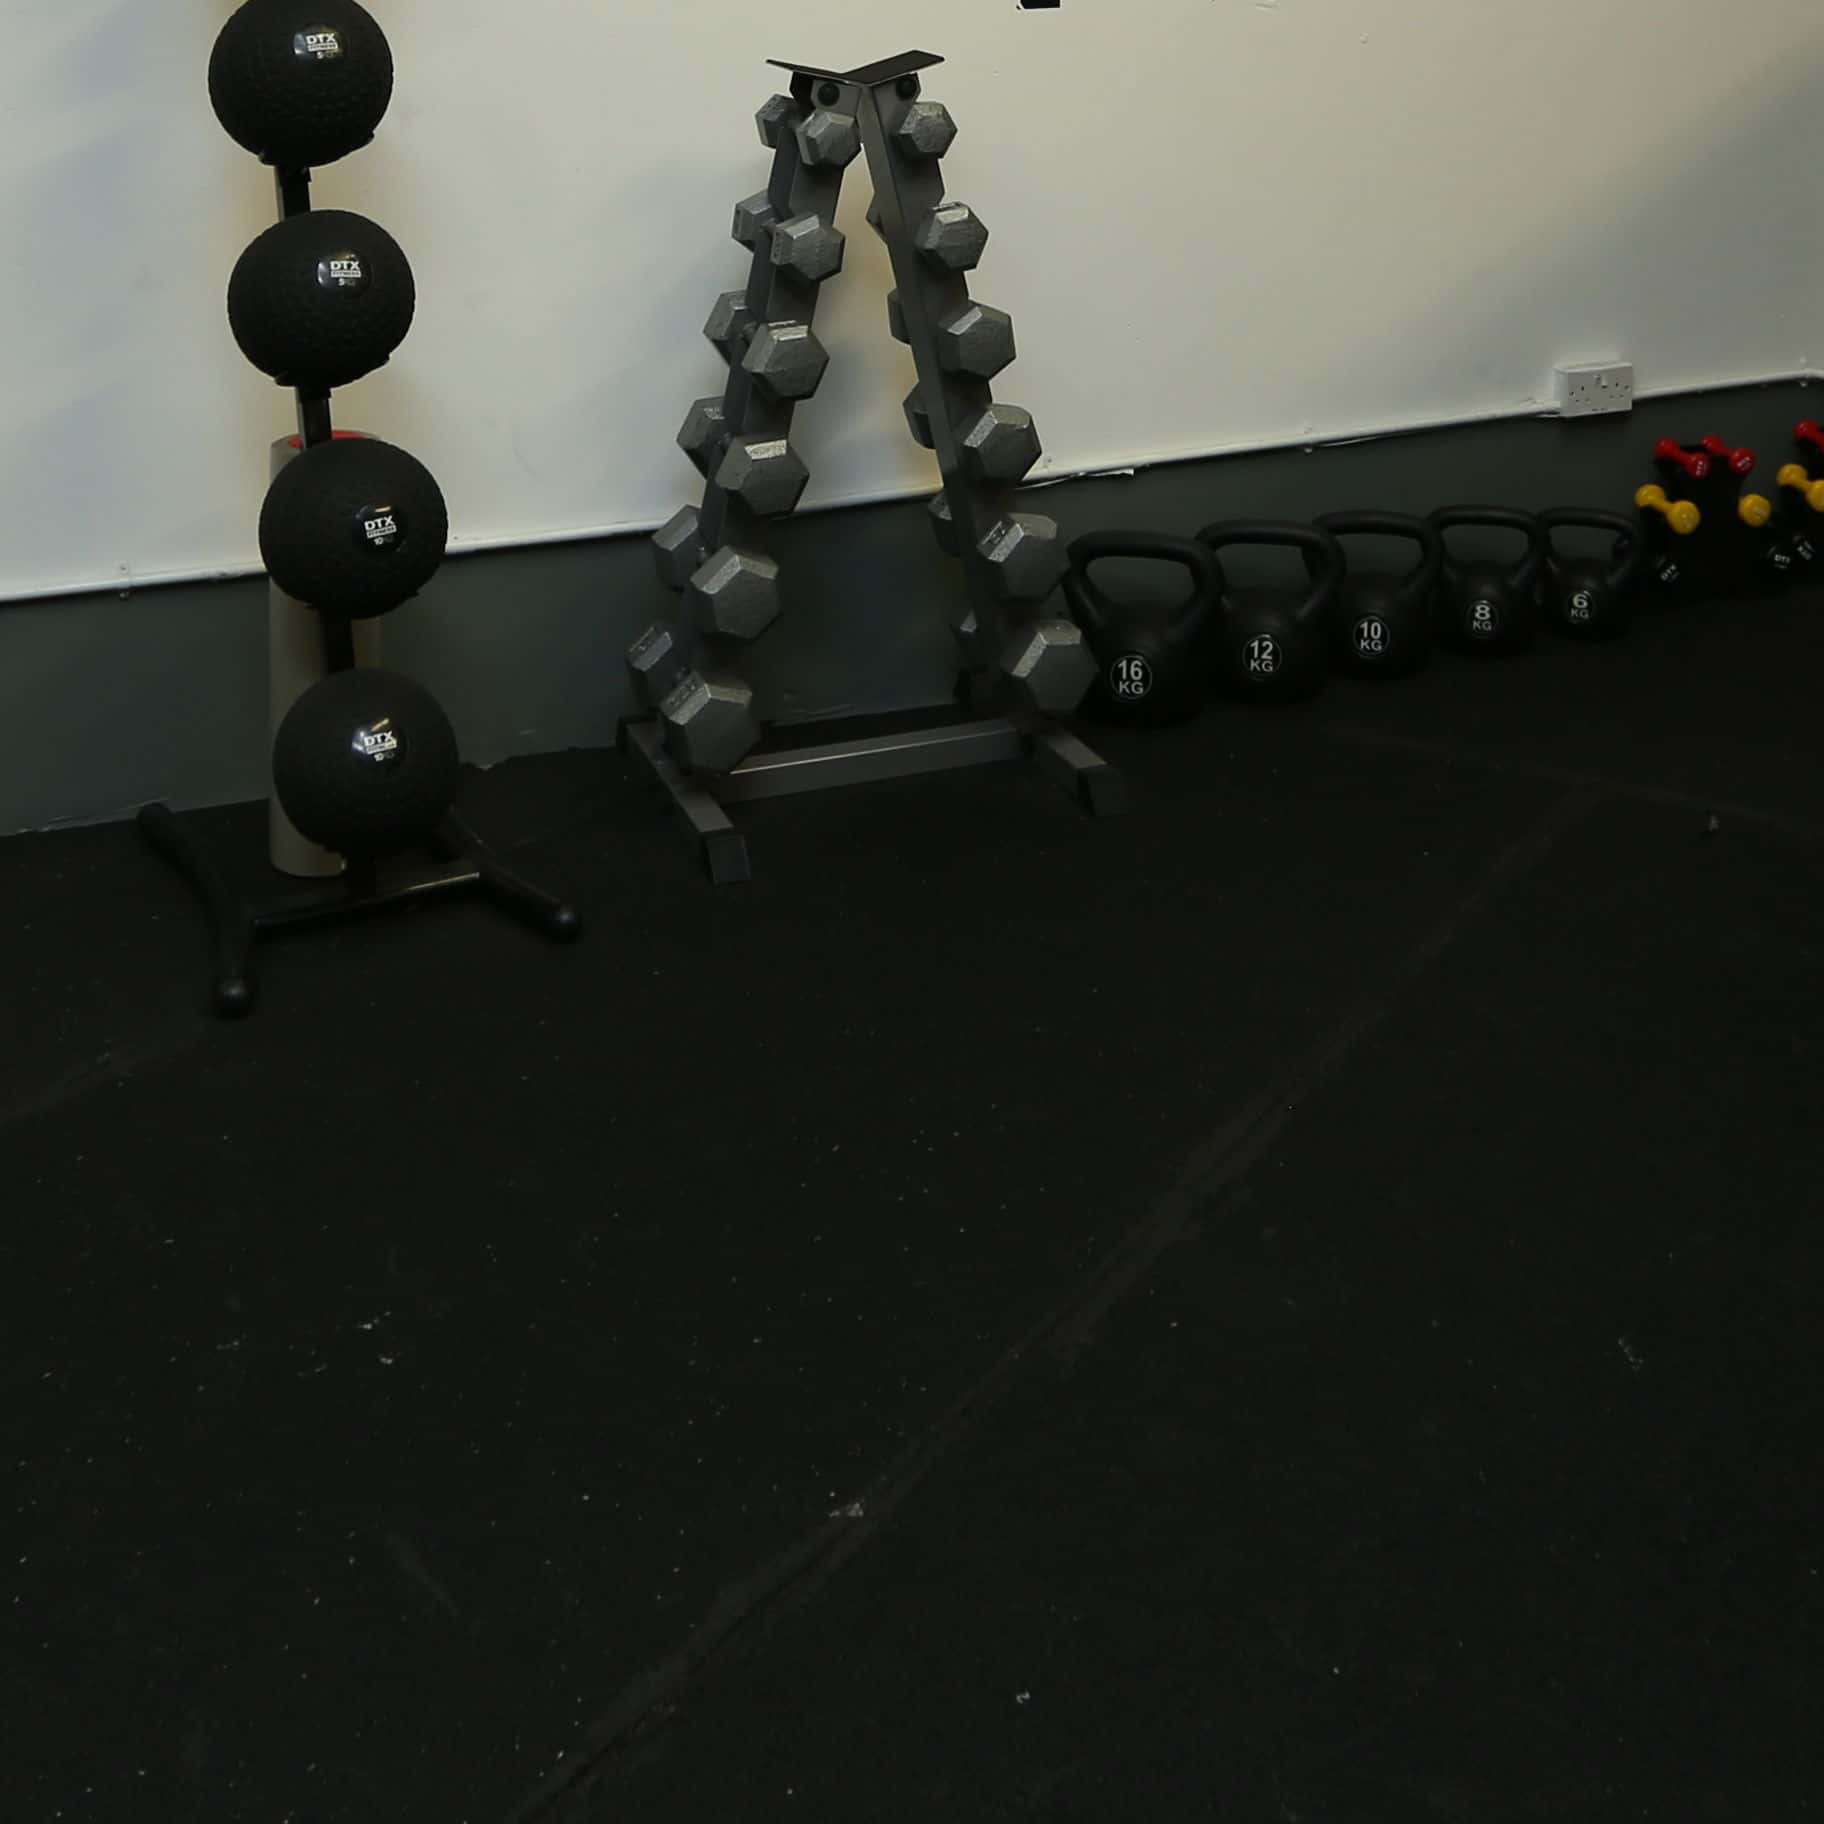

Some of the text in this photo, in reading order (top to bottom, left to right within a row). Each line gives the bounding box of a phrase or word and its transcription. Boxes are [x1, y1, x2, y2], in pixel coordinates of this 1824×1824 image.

[306, 33, 335, 45] DTX
[330, 260, 359, 270] DTX
[364, 515, 394, 530] DTX
[1572, 593, 1589, 608] 6
[1474, 603, 1491, 621] 8
[1359, 621, 1382, 639] 10
[1472, 620, 1492, 632] KG
[1249, 640, 1274, 660] 12
[1360, 638, 1383, 652] KG
[1116, 659, 1143, 681] 16
[1249, 658, 1274, 673] KG
[1118, 680, 1145, 695] KG
[364, 731, 393, 746] DTX
